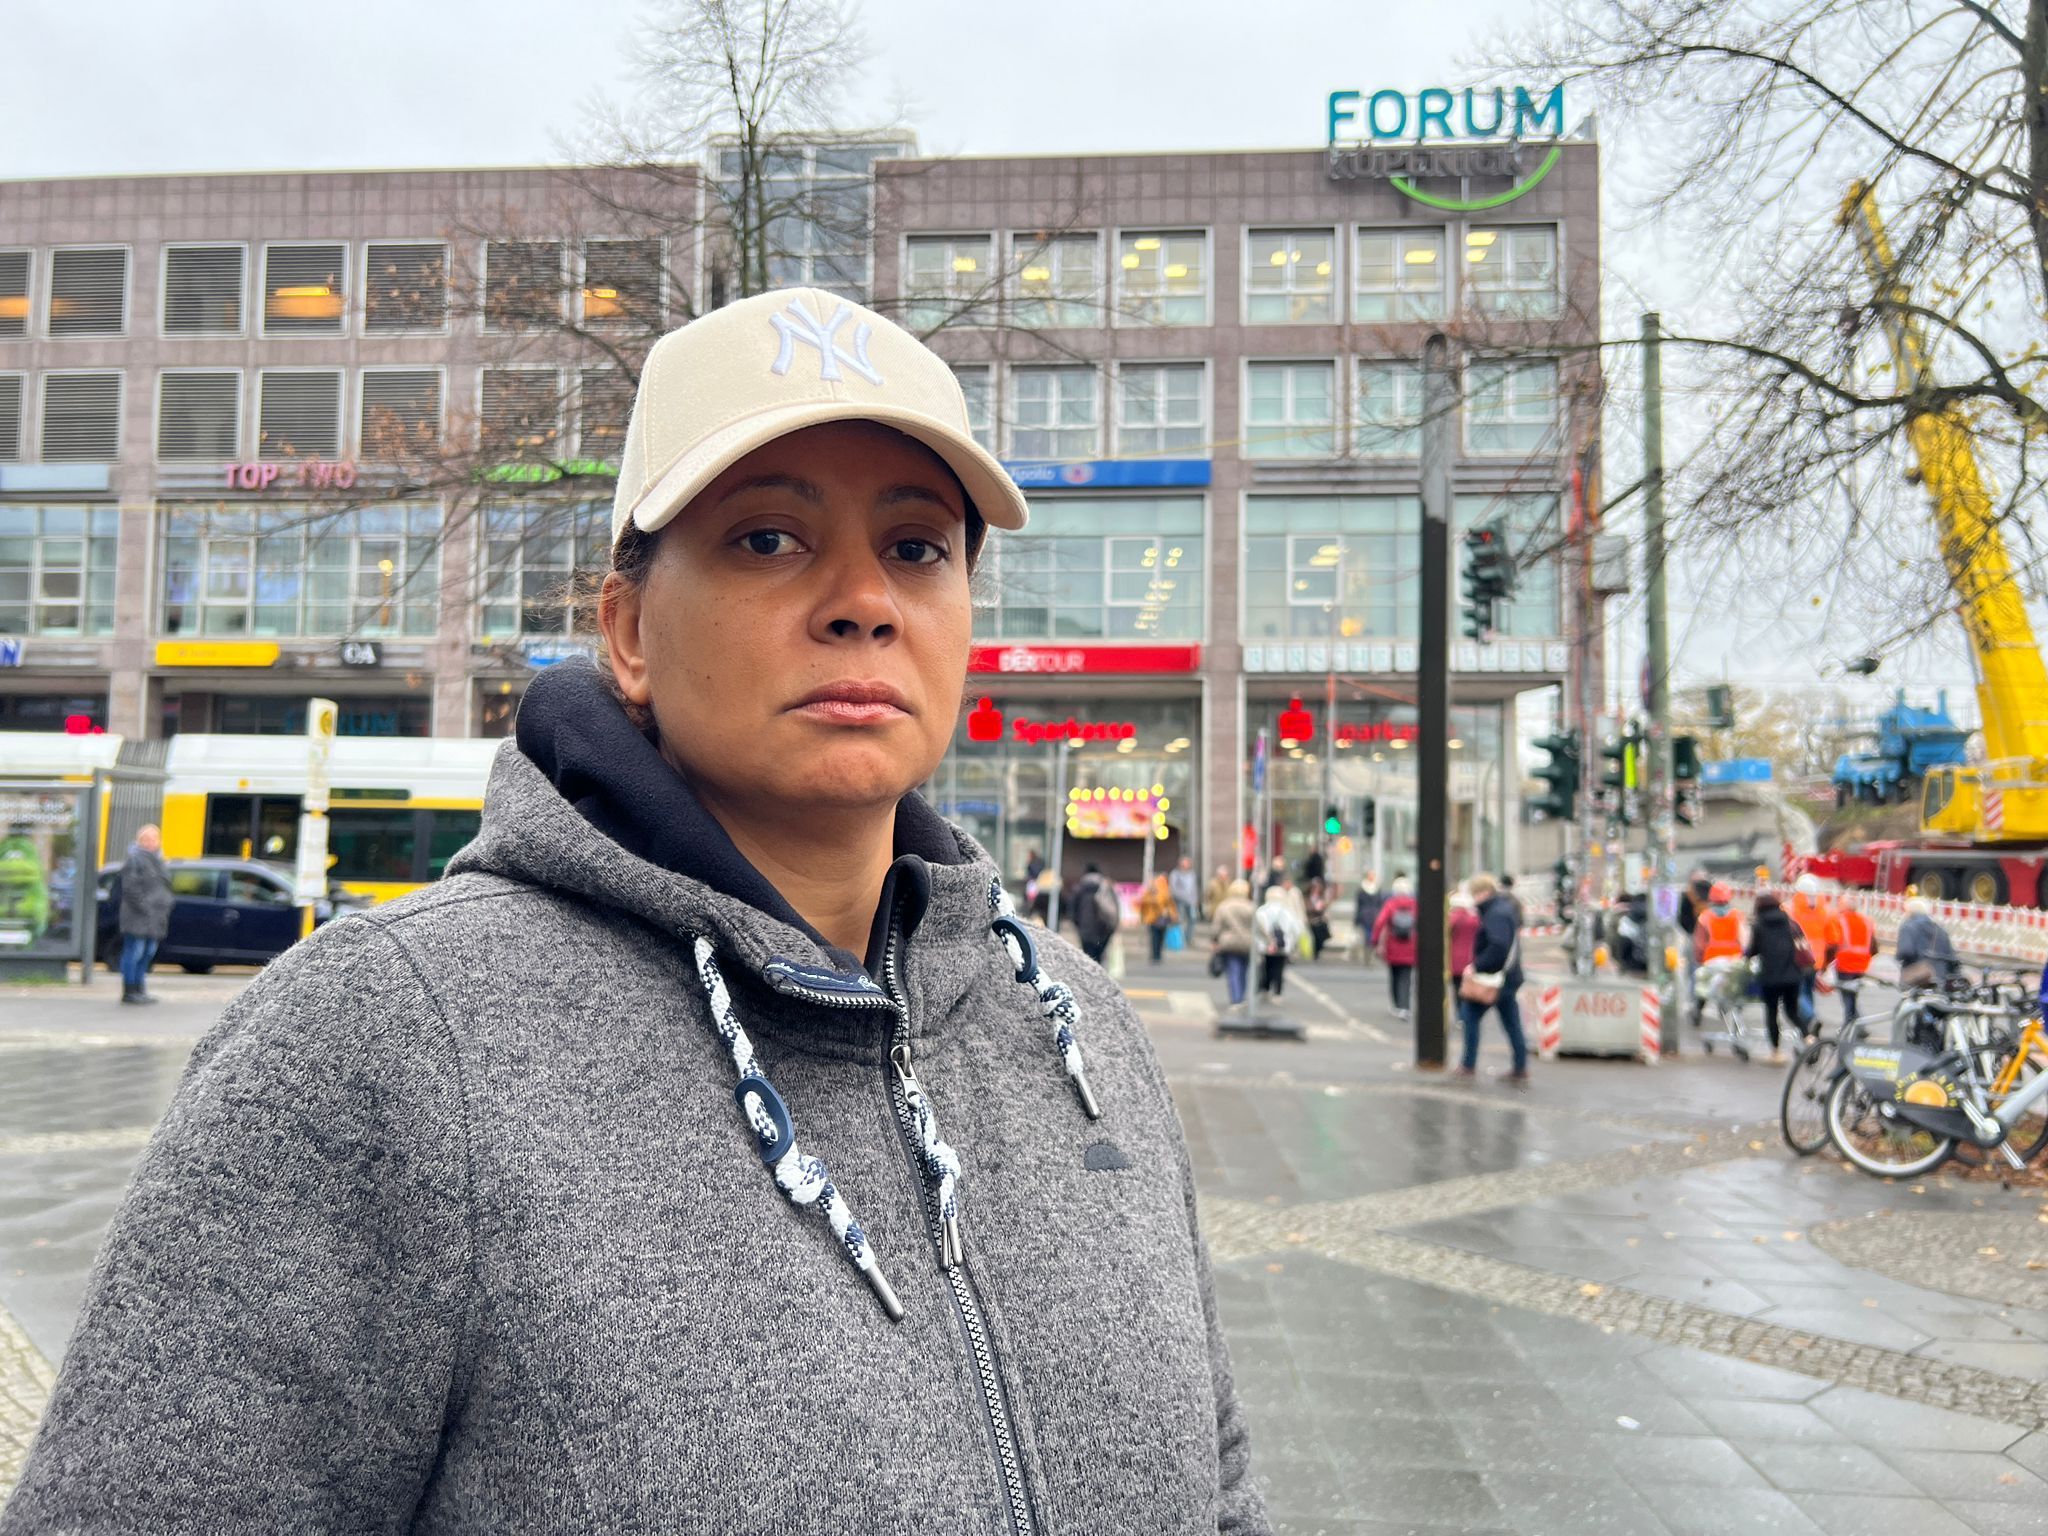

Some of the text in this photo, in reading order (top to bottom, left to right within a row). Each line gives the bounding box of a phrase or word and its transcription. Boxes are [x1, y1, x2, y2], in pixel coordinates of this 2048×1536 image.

[1329, 82, 1563, 144] FORUM
[768, 298, 885, 385] NY
[224, 460, 356, 490] TOP TWO
[1013, 717, 1137, 745] Sparkasse
[1572, 990, 1628, 1017] ABG
